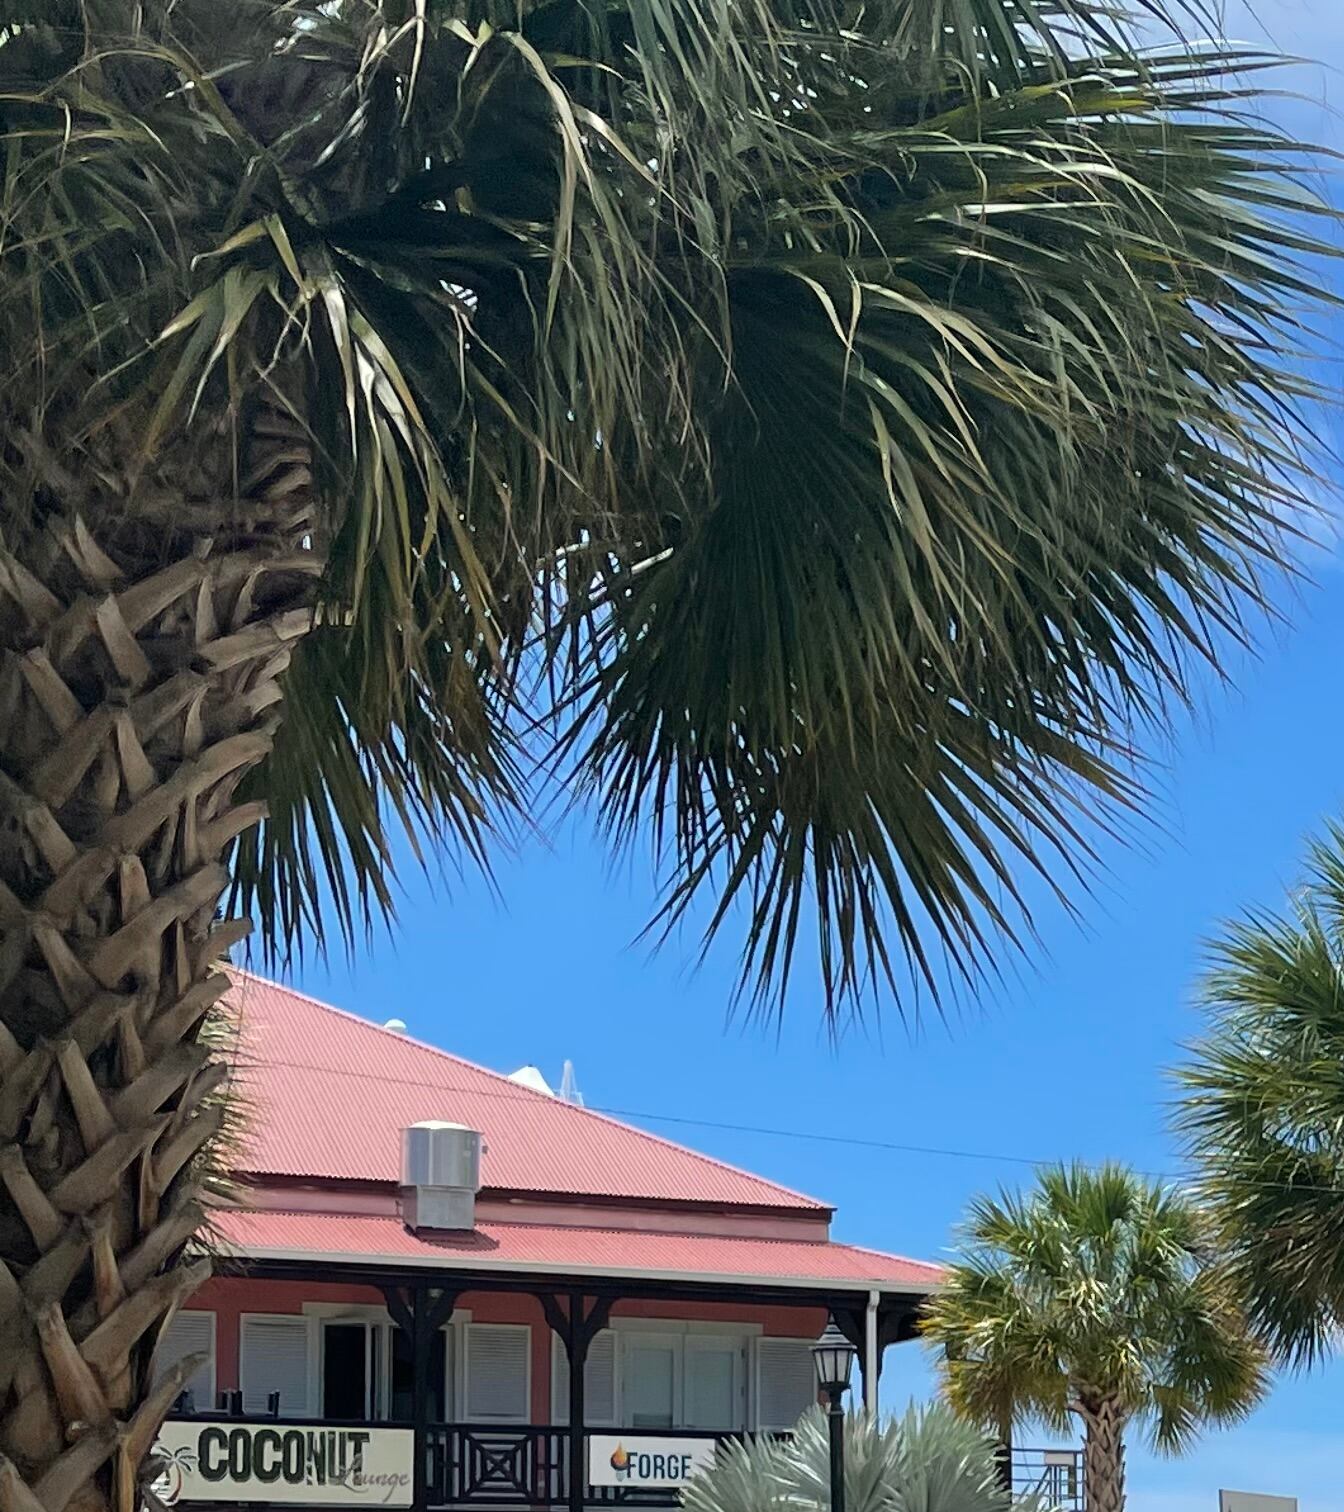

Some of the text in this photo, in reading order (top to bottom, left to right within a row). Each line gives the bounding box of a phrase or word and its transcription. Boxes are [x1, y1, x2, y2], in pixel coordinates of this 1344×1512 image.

[198, 1427, 370, 1486] COCONUT
[342, 1452, 409, 1503] Lounge
[626, 1451, 693, 1480] FORGE
